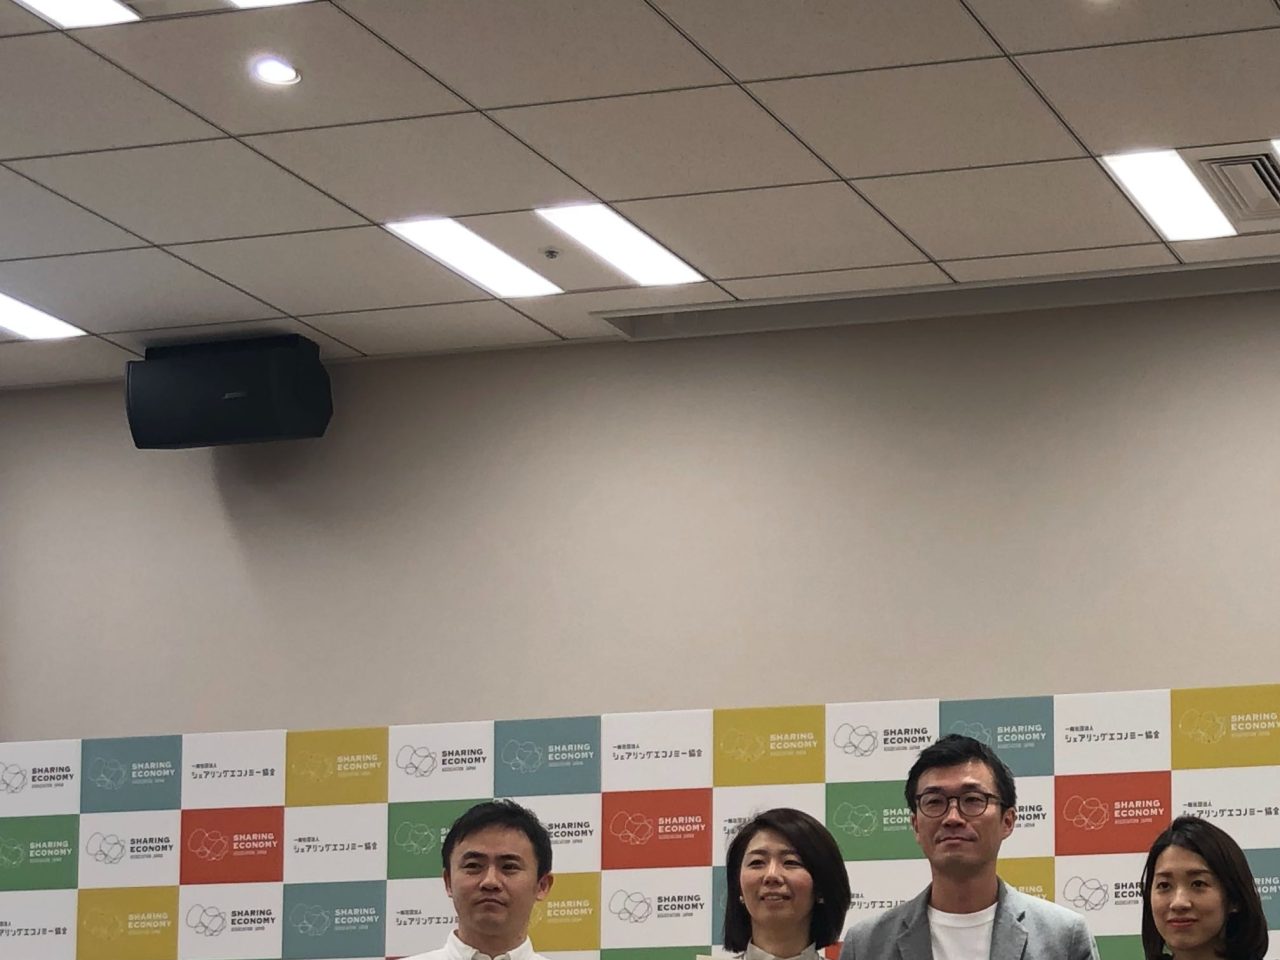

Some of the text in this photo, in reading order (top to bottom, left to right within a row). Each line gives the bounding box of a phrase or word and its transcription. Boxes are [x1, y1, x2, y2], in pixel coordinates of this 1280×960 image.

[883, 727, 927, 735] SHARING
[997, 724, 1042, 733] SHARING
[883, 735, 931, 744] ECONOMY
[997, 733, 1046, 741] ECONOMY
[548, 743, 590, 751] SHARING
[441, 748, 483, 756] SHARING
[547, 751, 593, 760] ECONOMY
[441, 756, 486, 765] ECONOMY
[131, 761, 171, 769] SHARING
[31, 766, 71, 774] SHARING
[131, 769, 175, 777] ECONOMY
[31, 773, 74, 781] ECONOMY
[1114, 799, 1160, 808] SHARING
[1114, 808, 1164, 817] ECONOMY
[658, 815, 701, 824] SHARING
[658, 824, 705, 832] ECONOMY
[130, 836, 169, 844] SHARING
[233, 832, 273, 840] SHARING
[129, 844, 173, 852] ECONOMY
[233, 840, 277, 848] ECONOMY
[657, 894, 700, 902] SHARING
[334, 907, 375, 915] SHARING
[657, 903, 704, 911] ECONOMY
